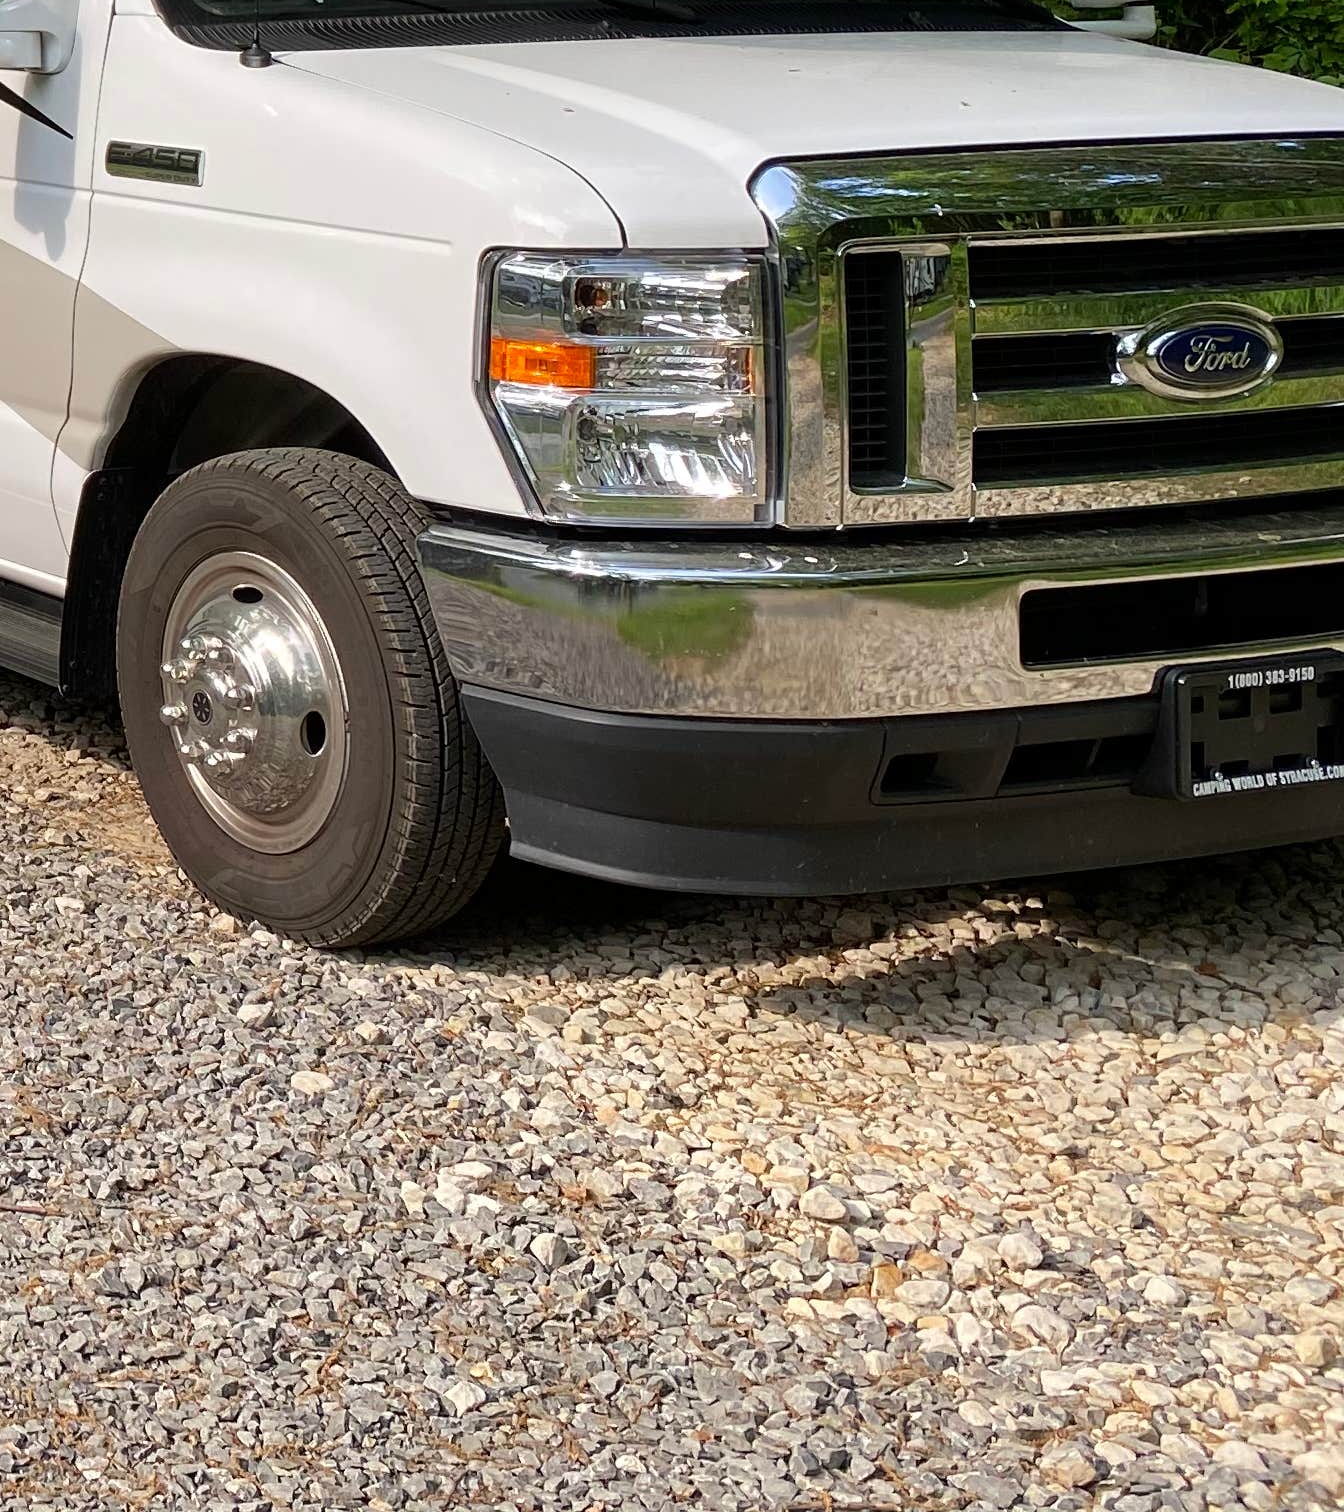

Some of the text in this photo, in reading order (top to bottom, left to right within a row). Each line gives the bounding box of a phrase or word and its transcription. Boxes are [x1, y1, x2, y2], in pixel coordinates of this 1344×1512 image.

[1184, 335, 1251, 372] Ford
[1193, 778, 1232, 797] CAMPING
[1231, 774, 1265, 791] WORLD
[1265, 772, 1278, 787] OF
